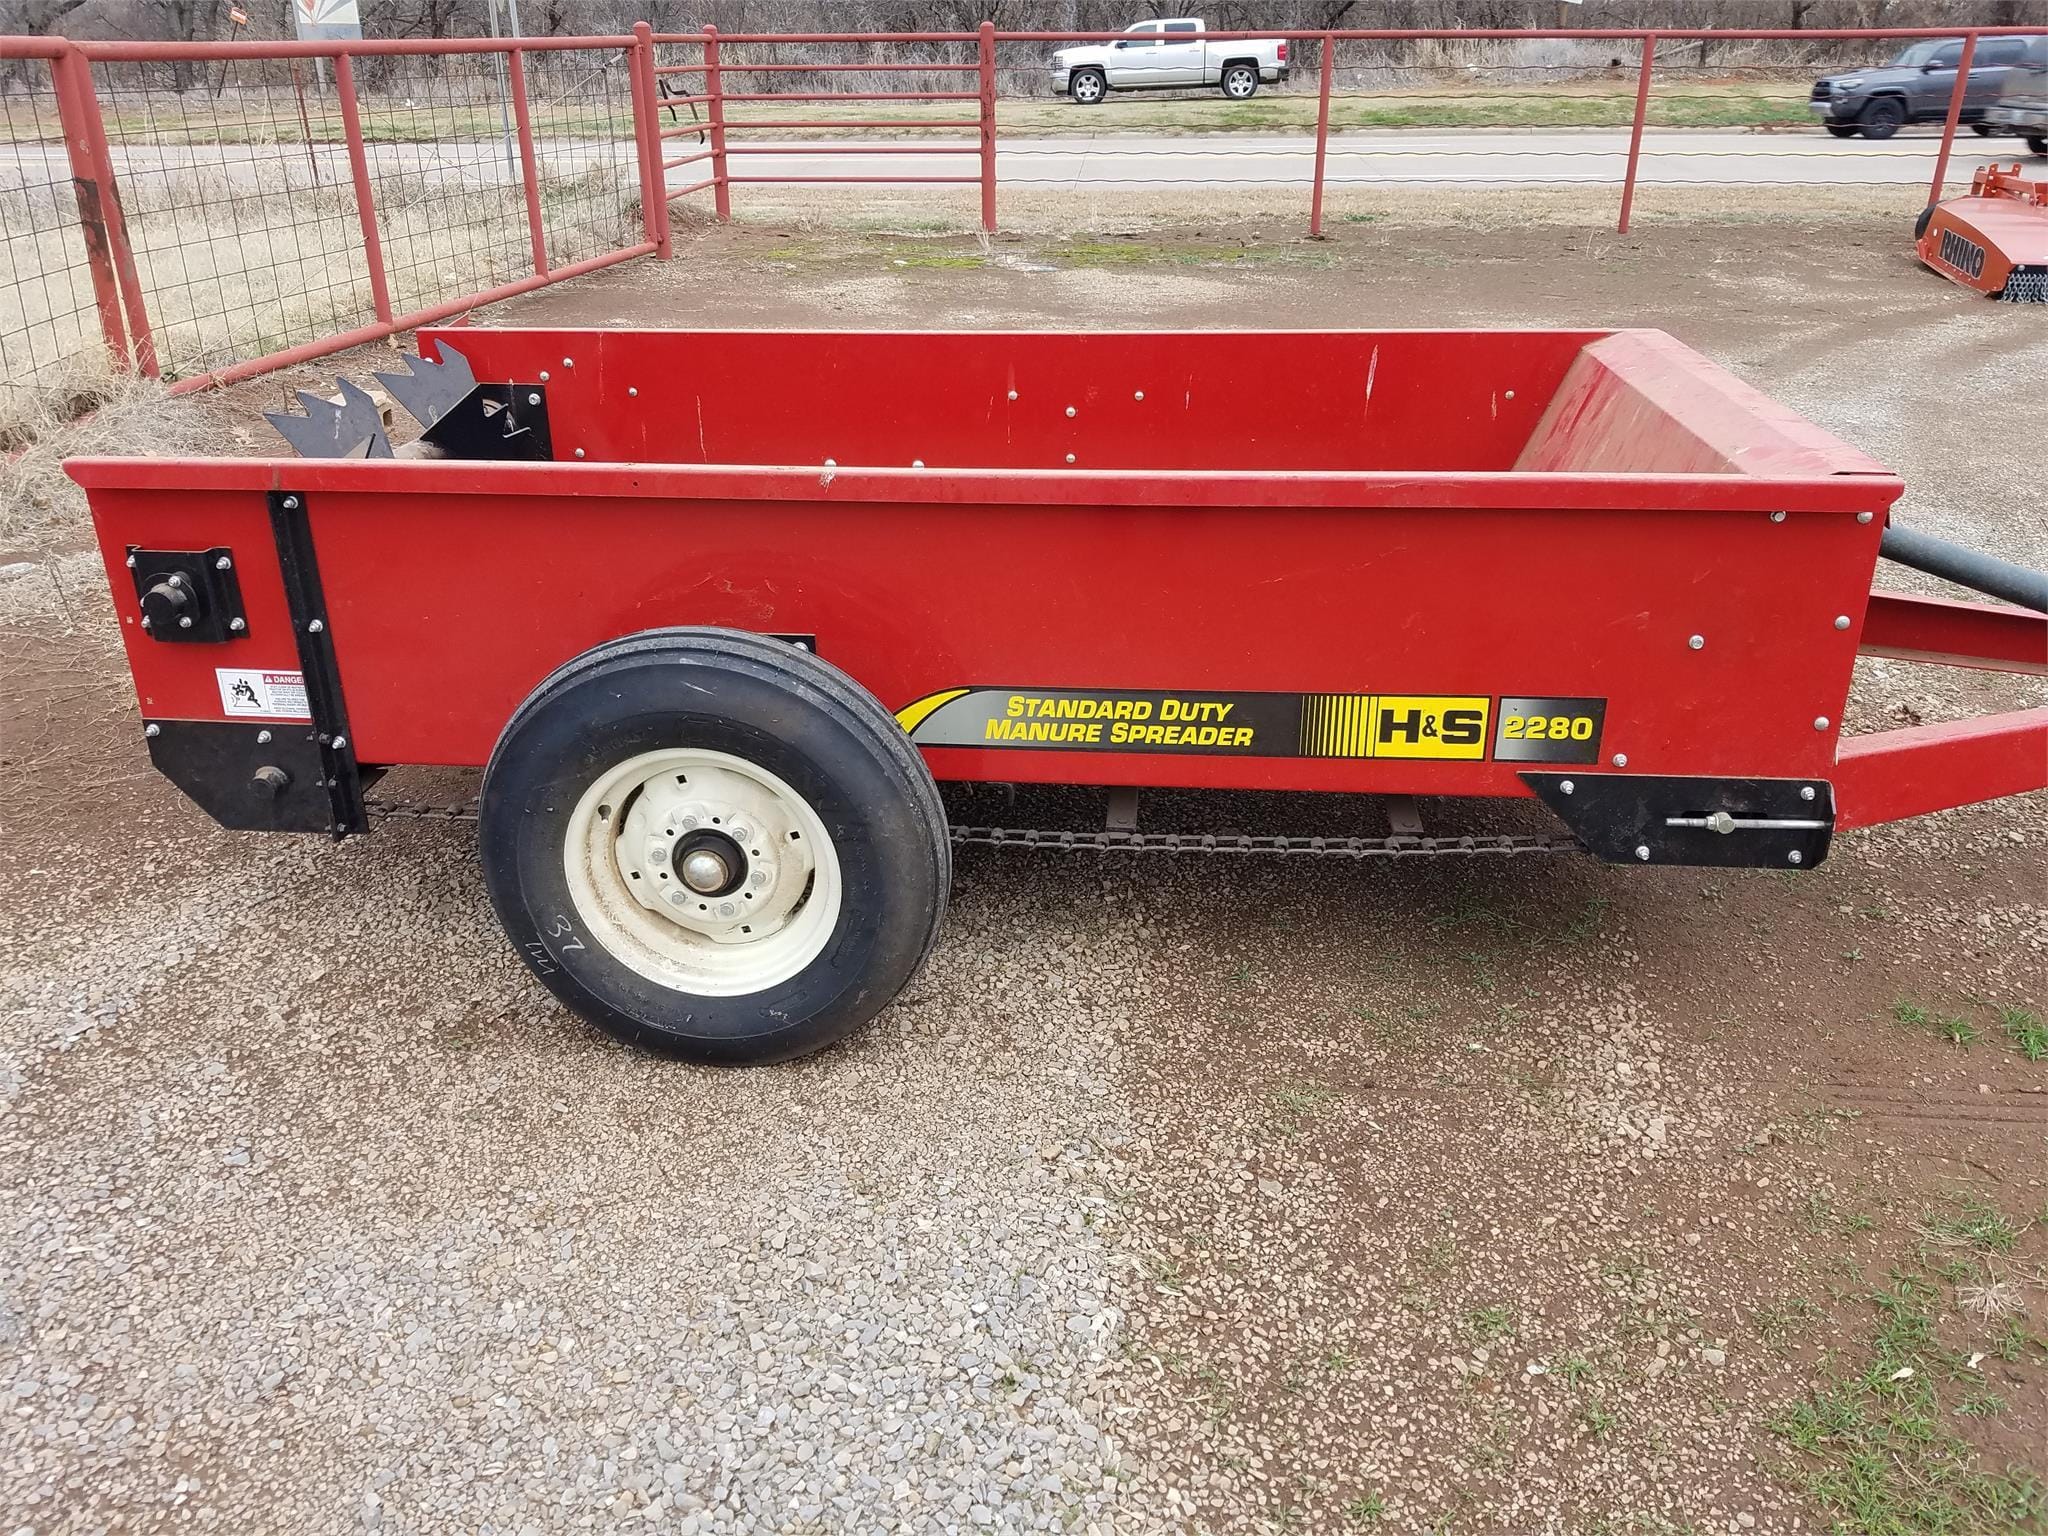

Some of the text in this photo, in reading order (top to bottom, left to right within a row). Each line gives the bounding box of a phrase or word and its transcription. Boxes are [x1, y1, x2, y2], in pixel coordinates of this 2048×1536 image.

[1938, 228, 1985, 279] RHINO
[273, 676, 304, 684] DANGE
[1007, 696, 1234, 721] STANDARD DUTY
[985, 719, 1254, 746] MANURE SPREADER
[1379, 709, 1482, 744] H&S
[1503, 716, 1593, 740] 2280
